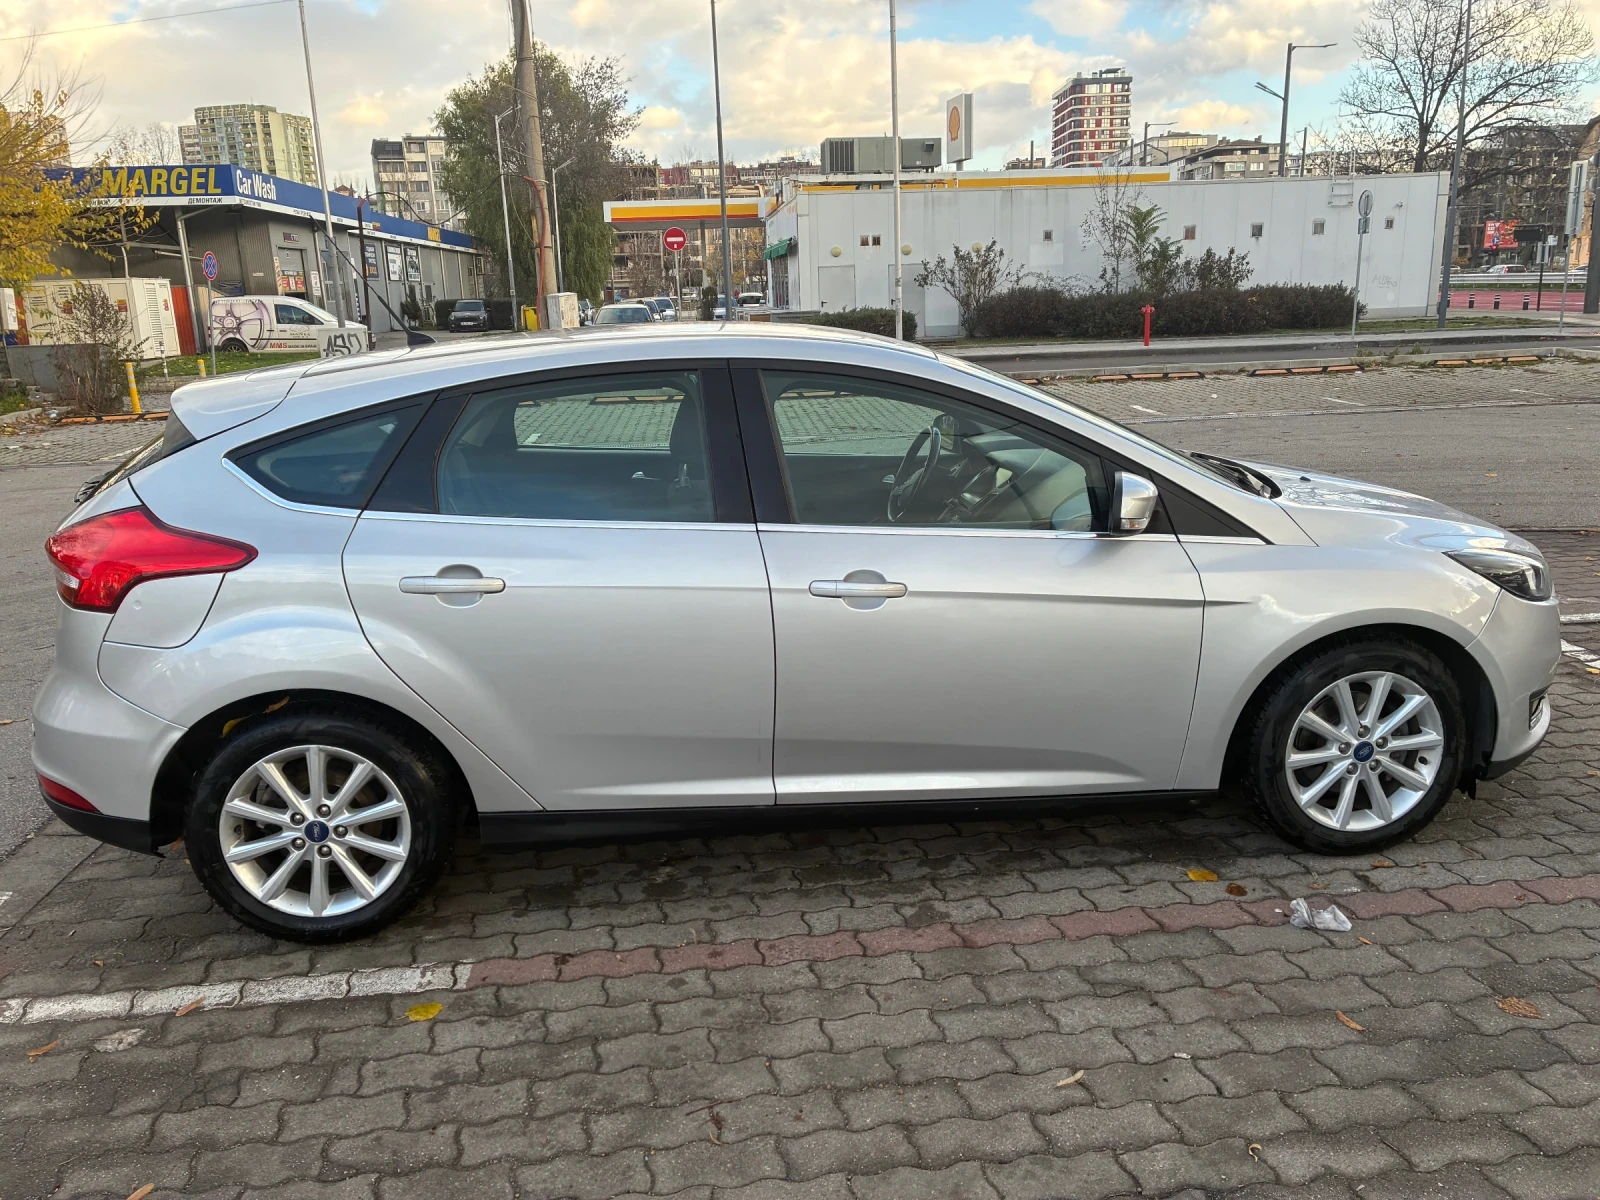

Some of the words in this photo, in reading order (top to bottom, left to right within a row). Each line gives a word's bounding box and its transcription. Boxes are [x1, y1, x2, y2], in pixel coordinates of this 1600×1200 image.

[102, 167, 222, 196] MARGEL
[236, 169, 251, 196] Car
[252, 173, 277, 201] Wash
[188, 196, 223, 205] ДЕМОНТАЖ
